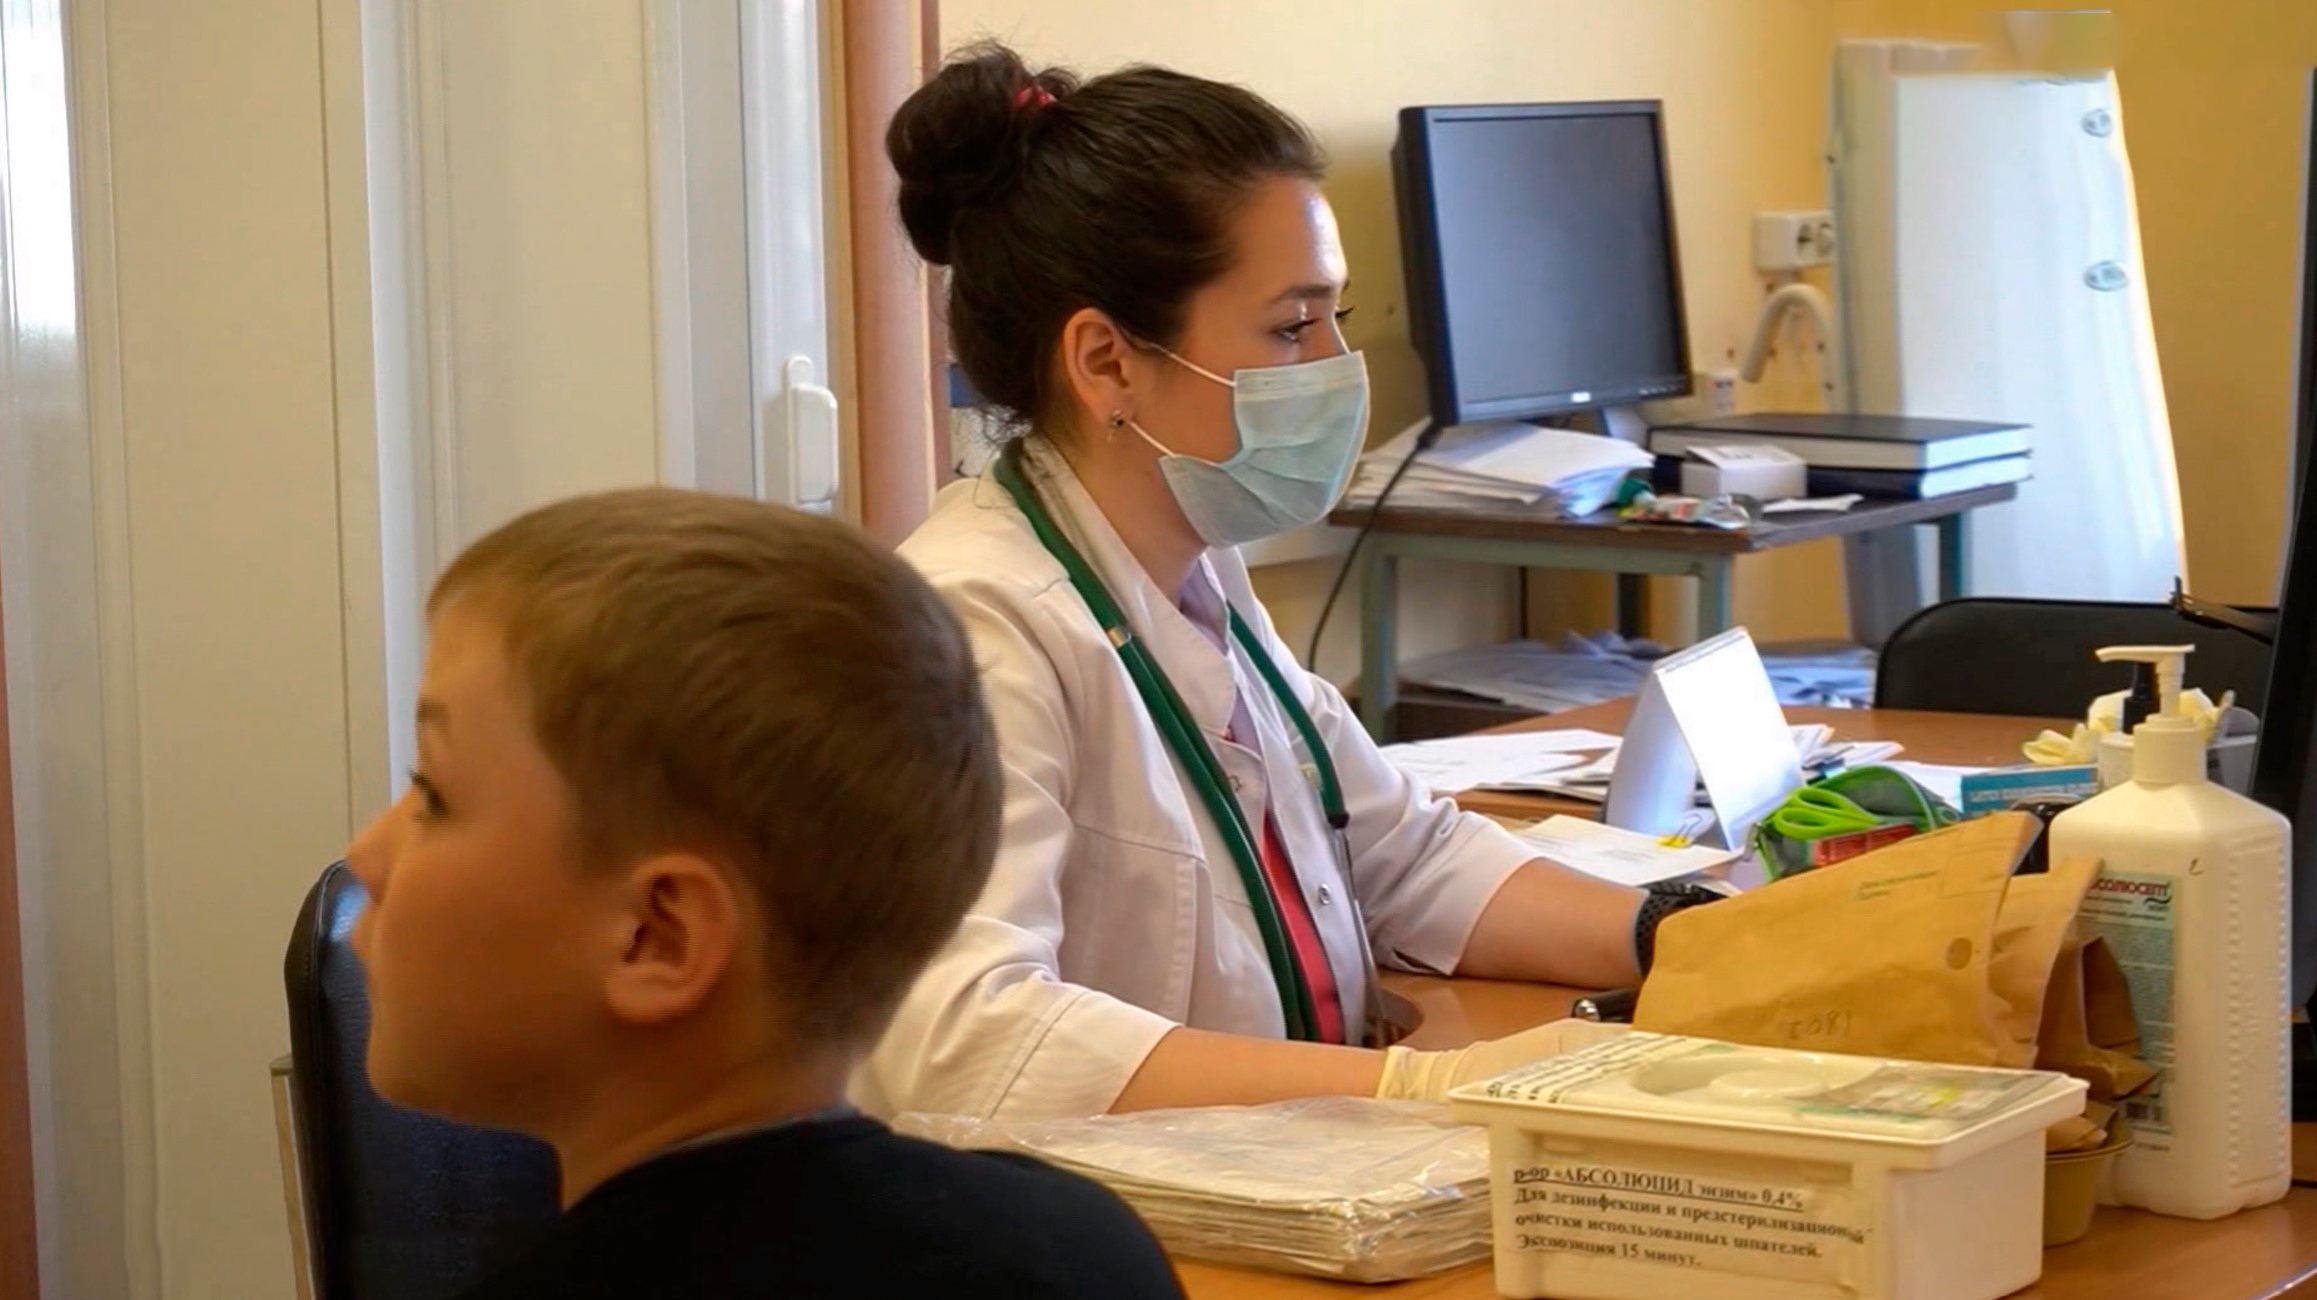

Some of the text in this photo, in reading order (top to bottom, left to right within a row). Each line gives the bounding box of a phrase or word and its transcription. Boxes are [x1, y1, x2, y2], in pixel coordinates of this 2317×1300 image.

[1514, 1187, 1548, 1204] Для
[1552, 1193, 1662, 1214] дезинфекции
[1666, 1204, 1678, 1216] и
[1554, 1166, 1694, 1196] «АБСОЛЮЦИД
[1761, 1187, 1804, 1209] 0,4%
[1515, 1212, 1823, 1258] очистки использованных шпателей.
[1516, 1233, 1702, 1266] Экспозиция 15 минут.
